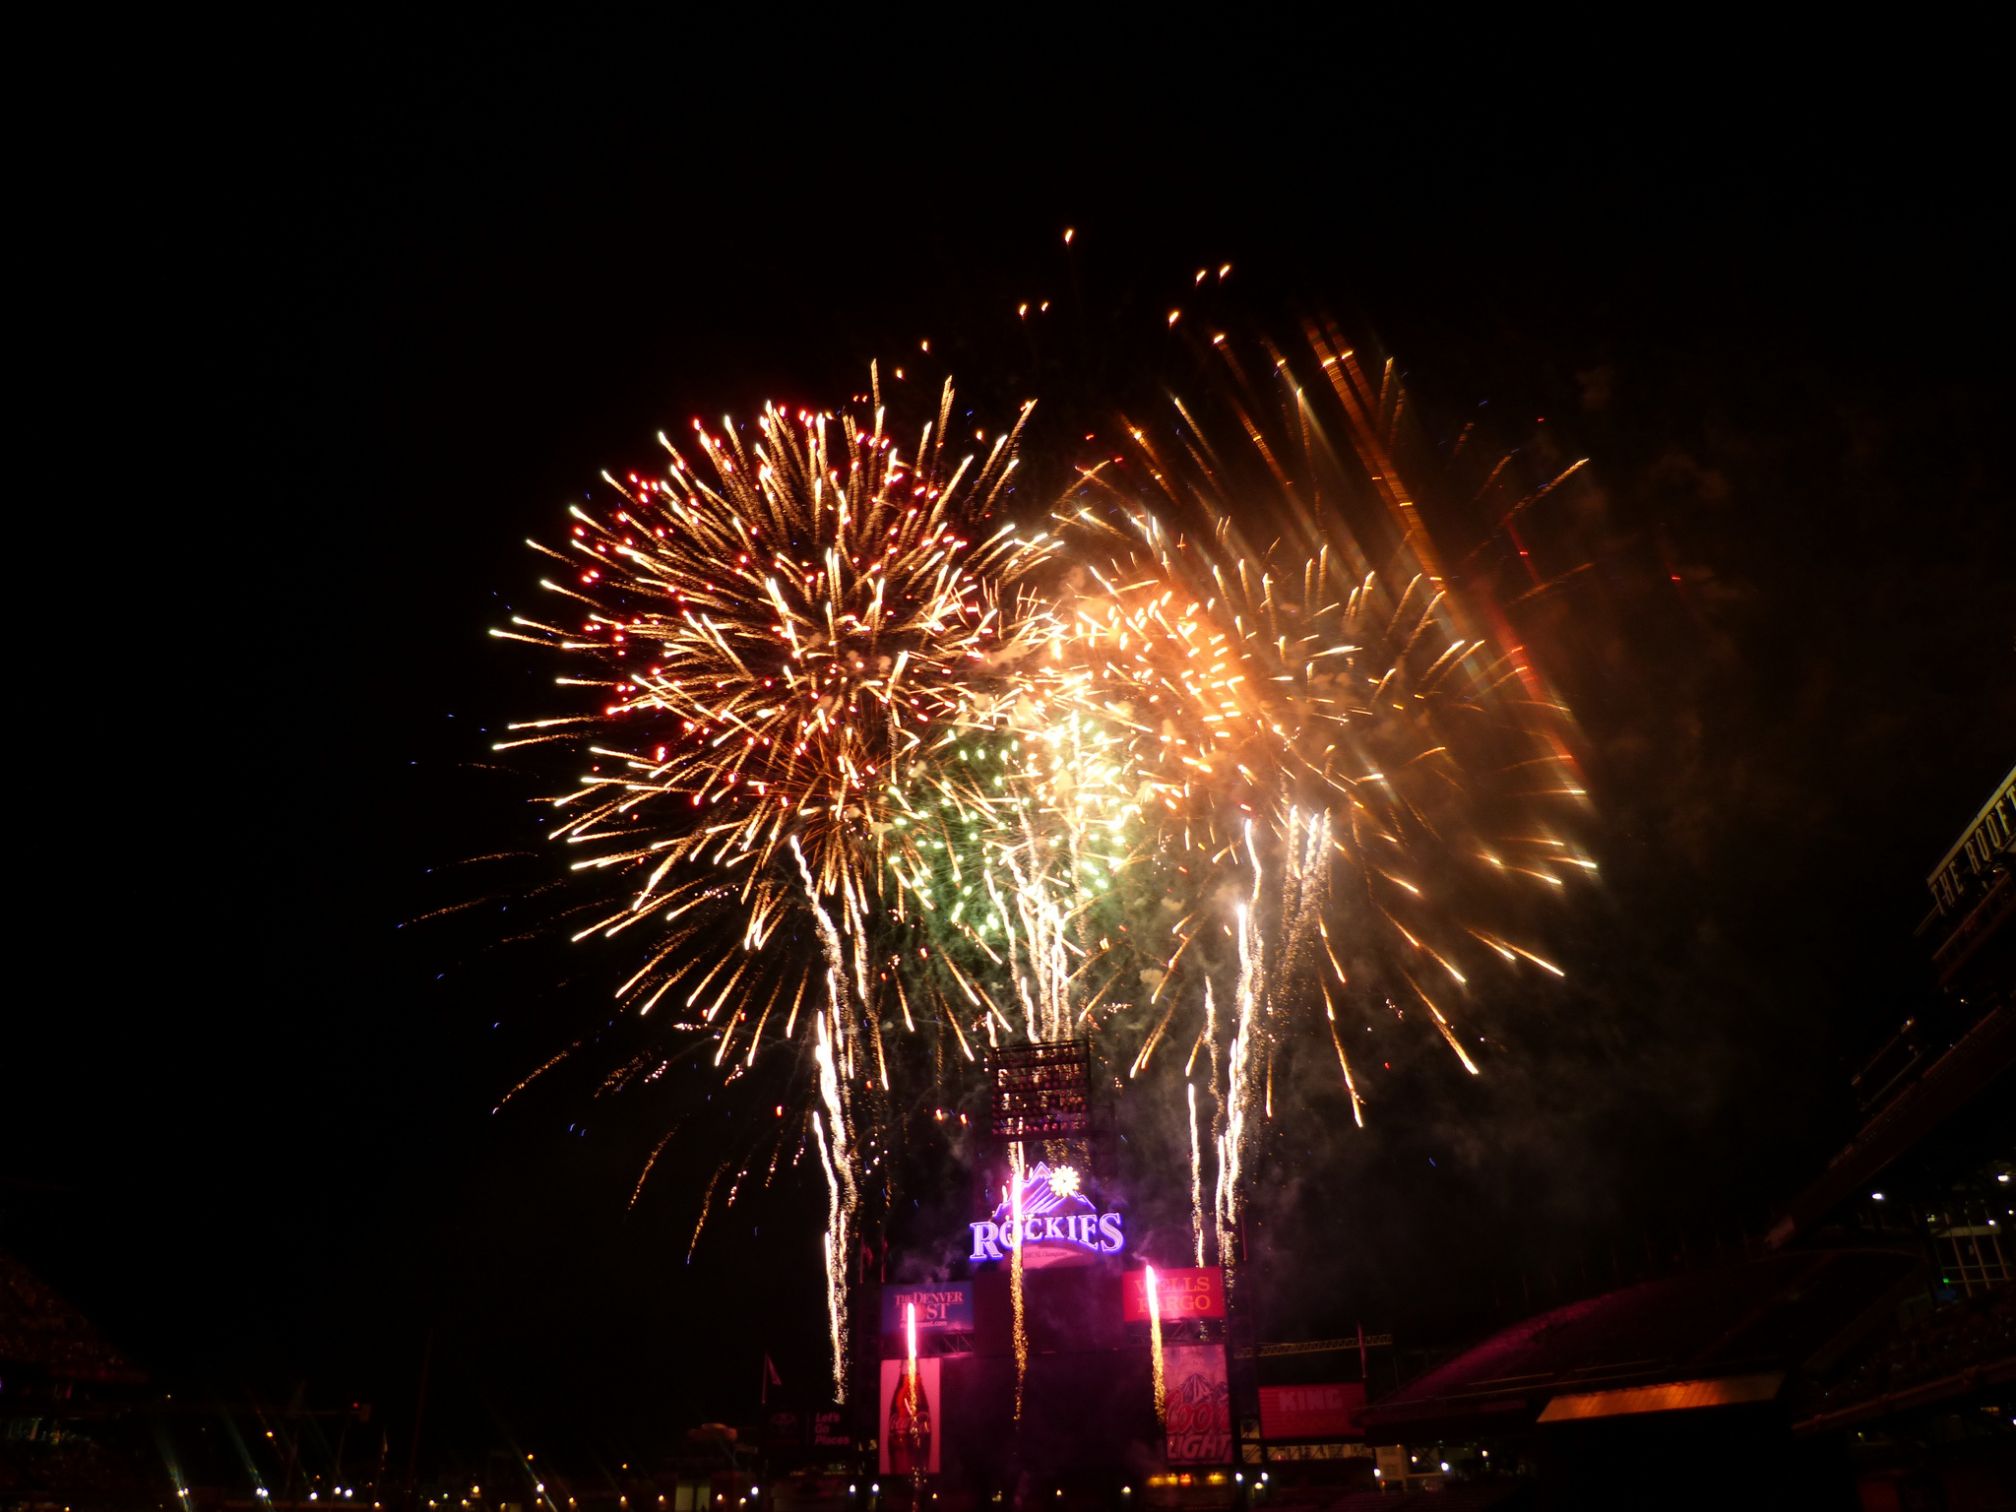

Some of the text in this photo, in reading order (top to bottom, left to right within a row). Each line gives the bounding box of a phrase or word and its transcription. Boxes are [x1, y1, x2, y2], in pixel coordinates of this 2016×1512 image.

[1930, 859, 1965, 918] THE
[969, 1212, 1125, 1260] ROCKIES
[913, 1291, 963, 1304] DENVER
[1136, 1295, 1211, 1313] FRGO
[1278, 1388, 1343, 1412] KING
[1166, 1433, 1232, 1462] LIGHT
